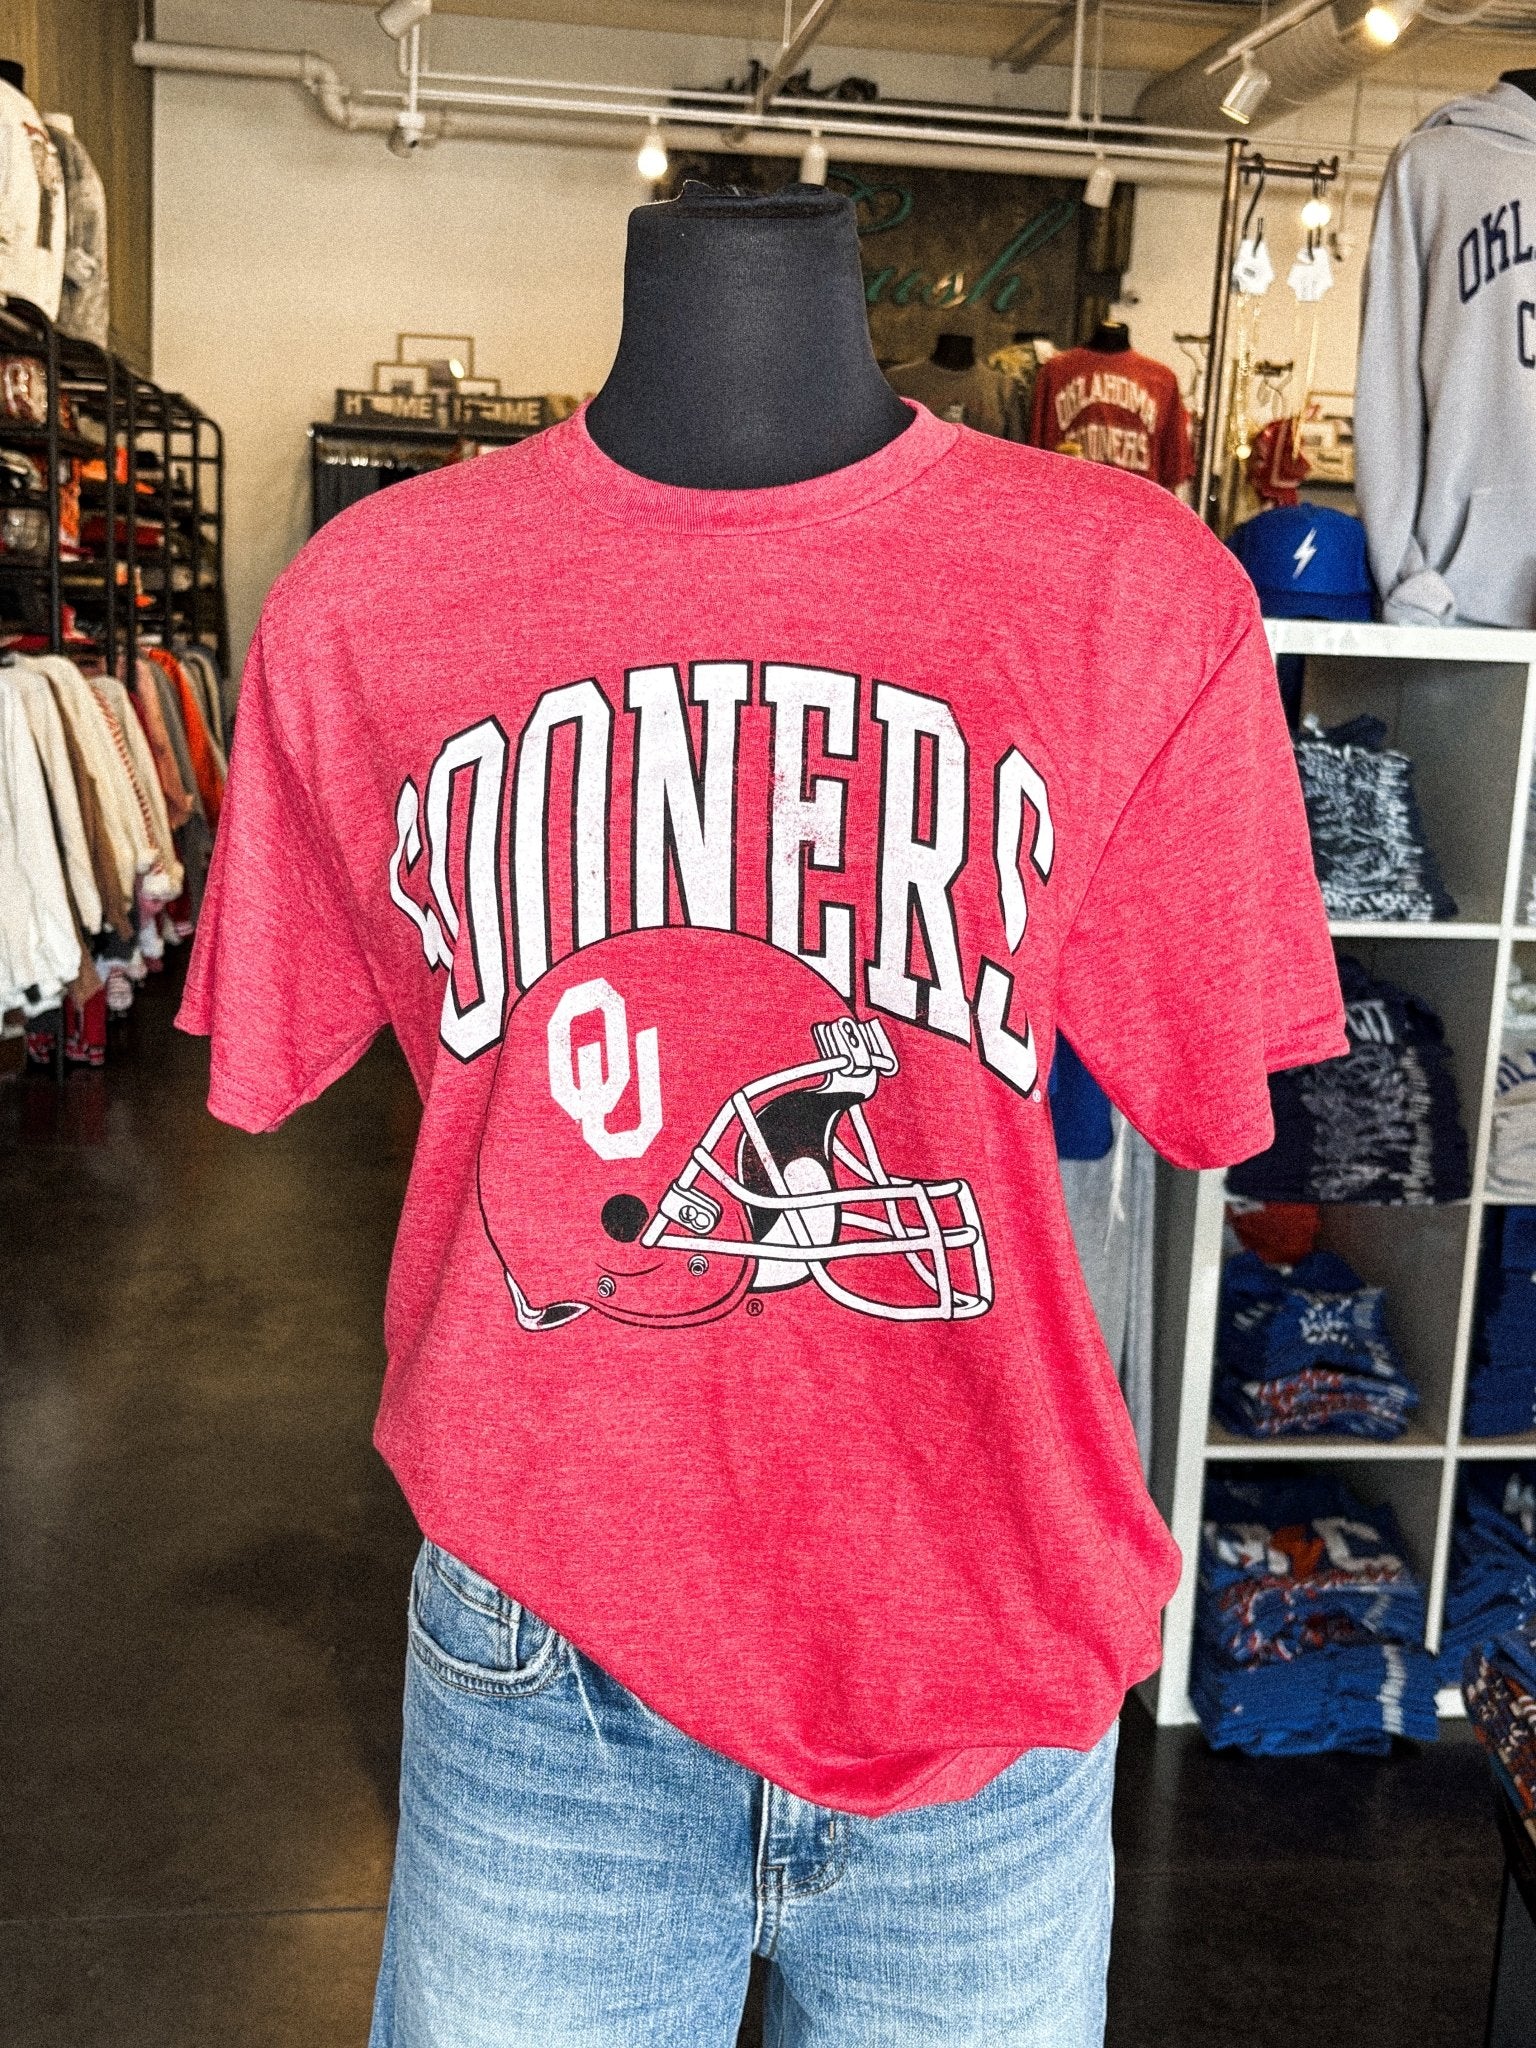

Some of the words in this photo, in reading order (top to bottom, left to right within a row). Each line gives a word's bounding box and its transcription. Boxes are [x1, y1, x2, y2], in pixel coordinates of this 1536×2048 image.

[1458, 199, 1536, 305] OKL
[388, 661, 1053, 1099] SOONERS
[547, 977, 664, 1160] OU
